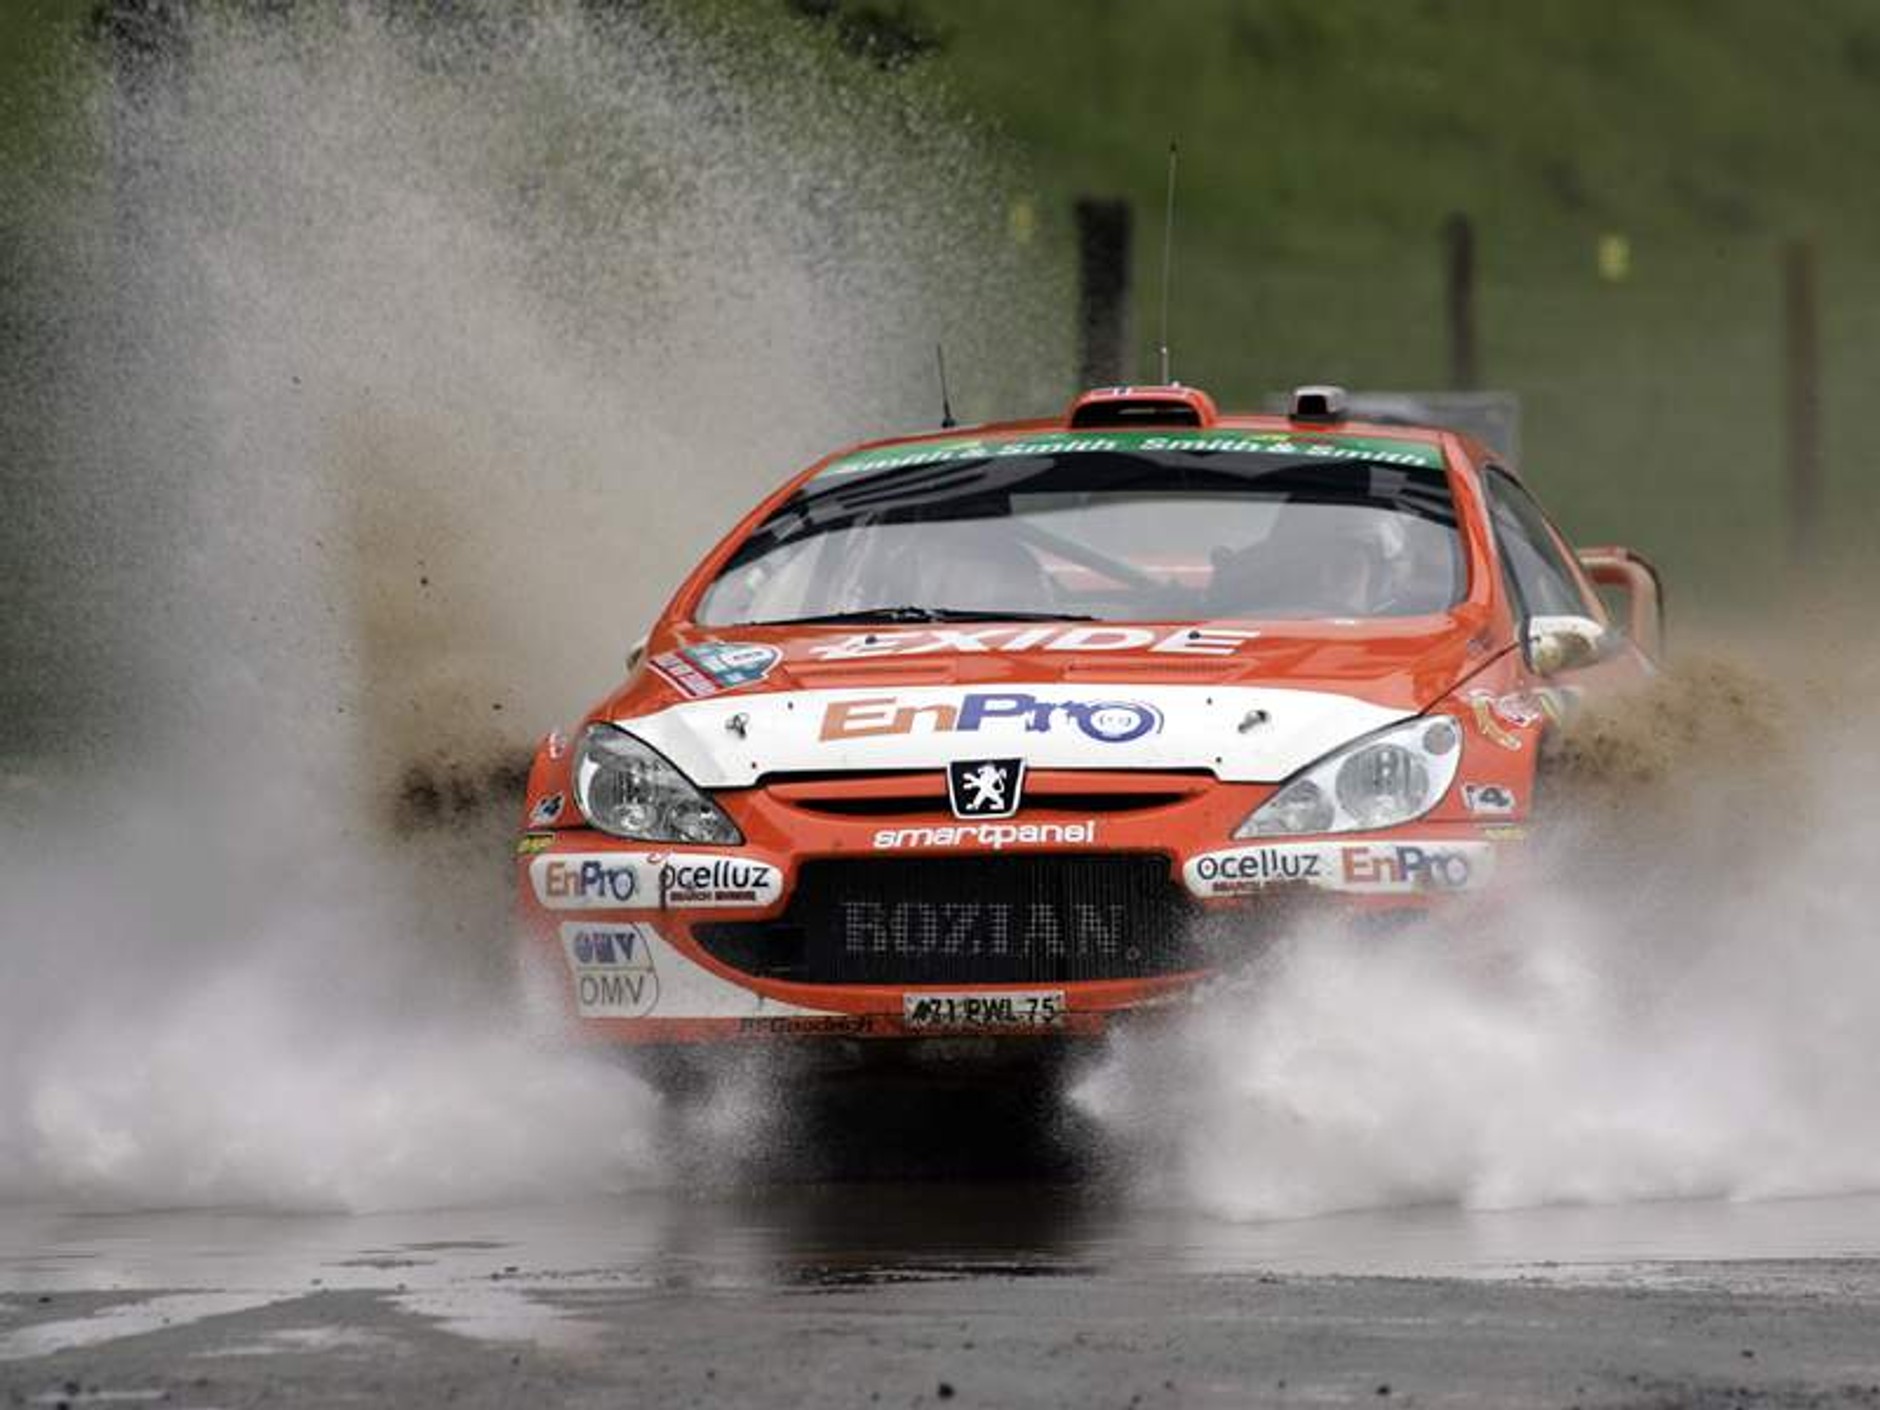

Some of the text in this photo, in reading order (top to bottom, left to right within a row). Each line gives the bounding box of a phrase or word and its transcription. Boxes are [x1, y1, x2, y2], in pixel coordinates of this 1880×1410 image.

[997, 439, 1117, 454] Smith
[1140, 438, 1427, 466] Smith & Smith
[809, 629, 1262, 660] EXIDE
[818, 692, 1155, 743] EnPro
[873, 820, 1095, 850] smartpanel
[1197, 848, 1320, 880] ocelluz
[1343, 846, 1468, 886] EnPro
[546, 860, 635, 902] EnPro
[574, 931, 635, 963] OMV
[581, 974, 643, 1006] OMV
[1026, 998, 1055, 1022] 75
